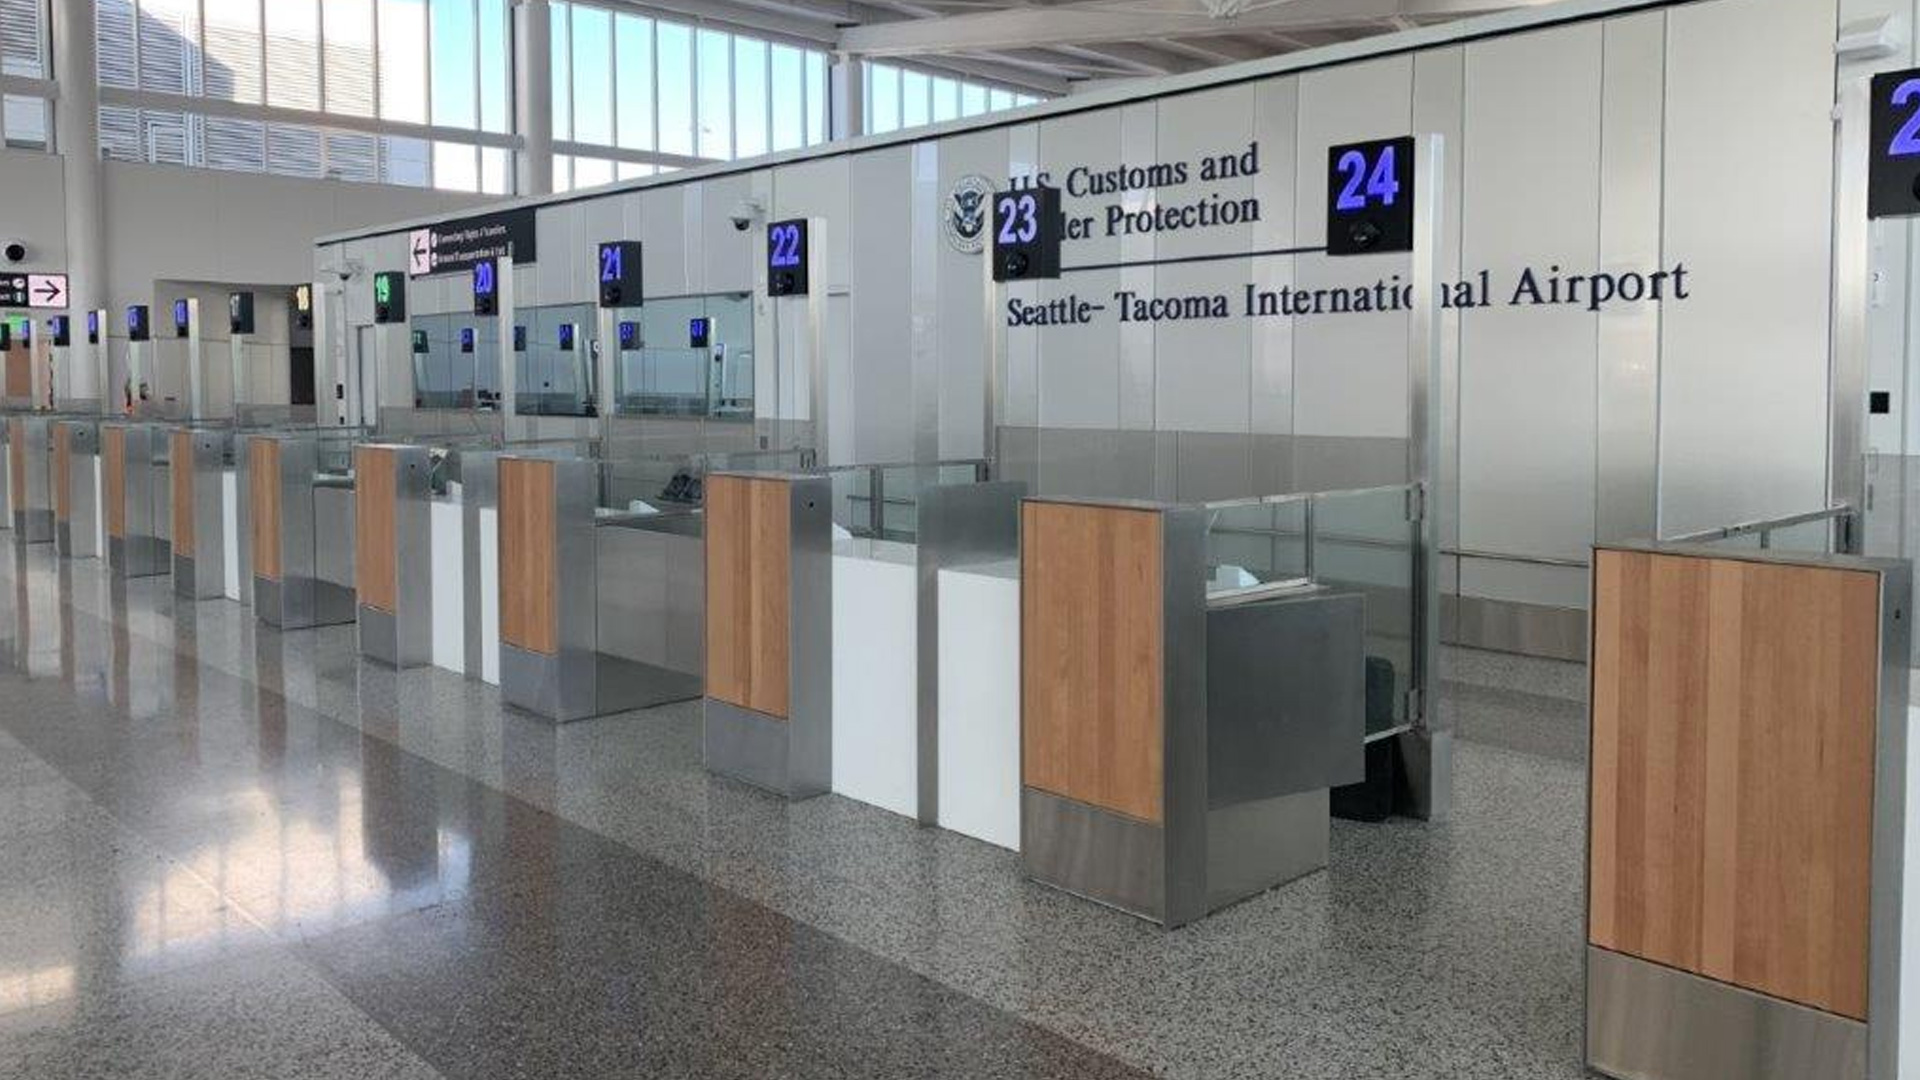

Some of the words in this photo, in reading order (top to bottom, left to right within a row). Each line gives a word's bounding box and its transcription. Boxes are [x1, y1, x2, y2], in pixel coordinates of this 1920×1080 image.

[1067, 162, 1187, 198] Customs
[1201, 142, 1259, 181] and
[1337, 146, 1400, 210] 24
[998, 195, 1037, 244] 23
[1106, 191, 1259, 236] Protection
[602, 247, 622, 280] 21
[770, 225, 800, 266] 22
[376, 274, 389, 303] 19
[474, 262, 492, 294] 20
[1007, 297, 1104, 326] Seattle-
[1116, 292, 1229, 322] Tacoma
[1509, 262, 1690, 311] Airport
